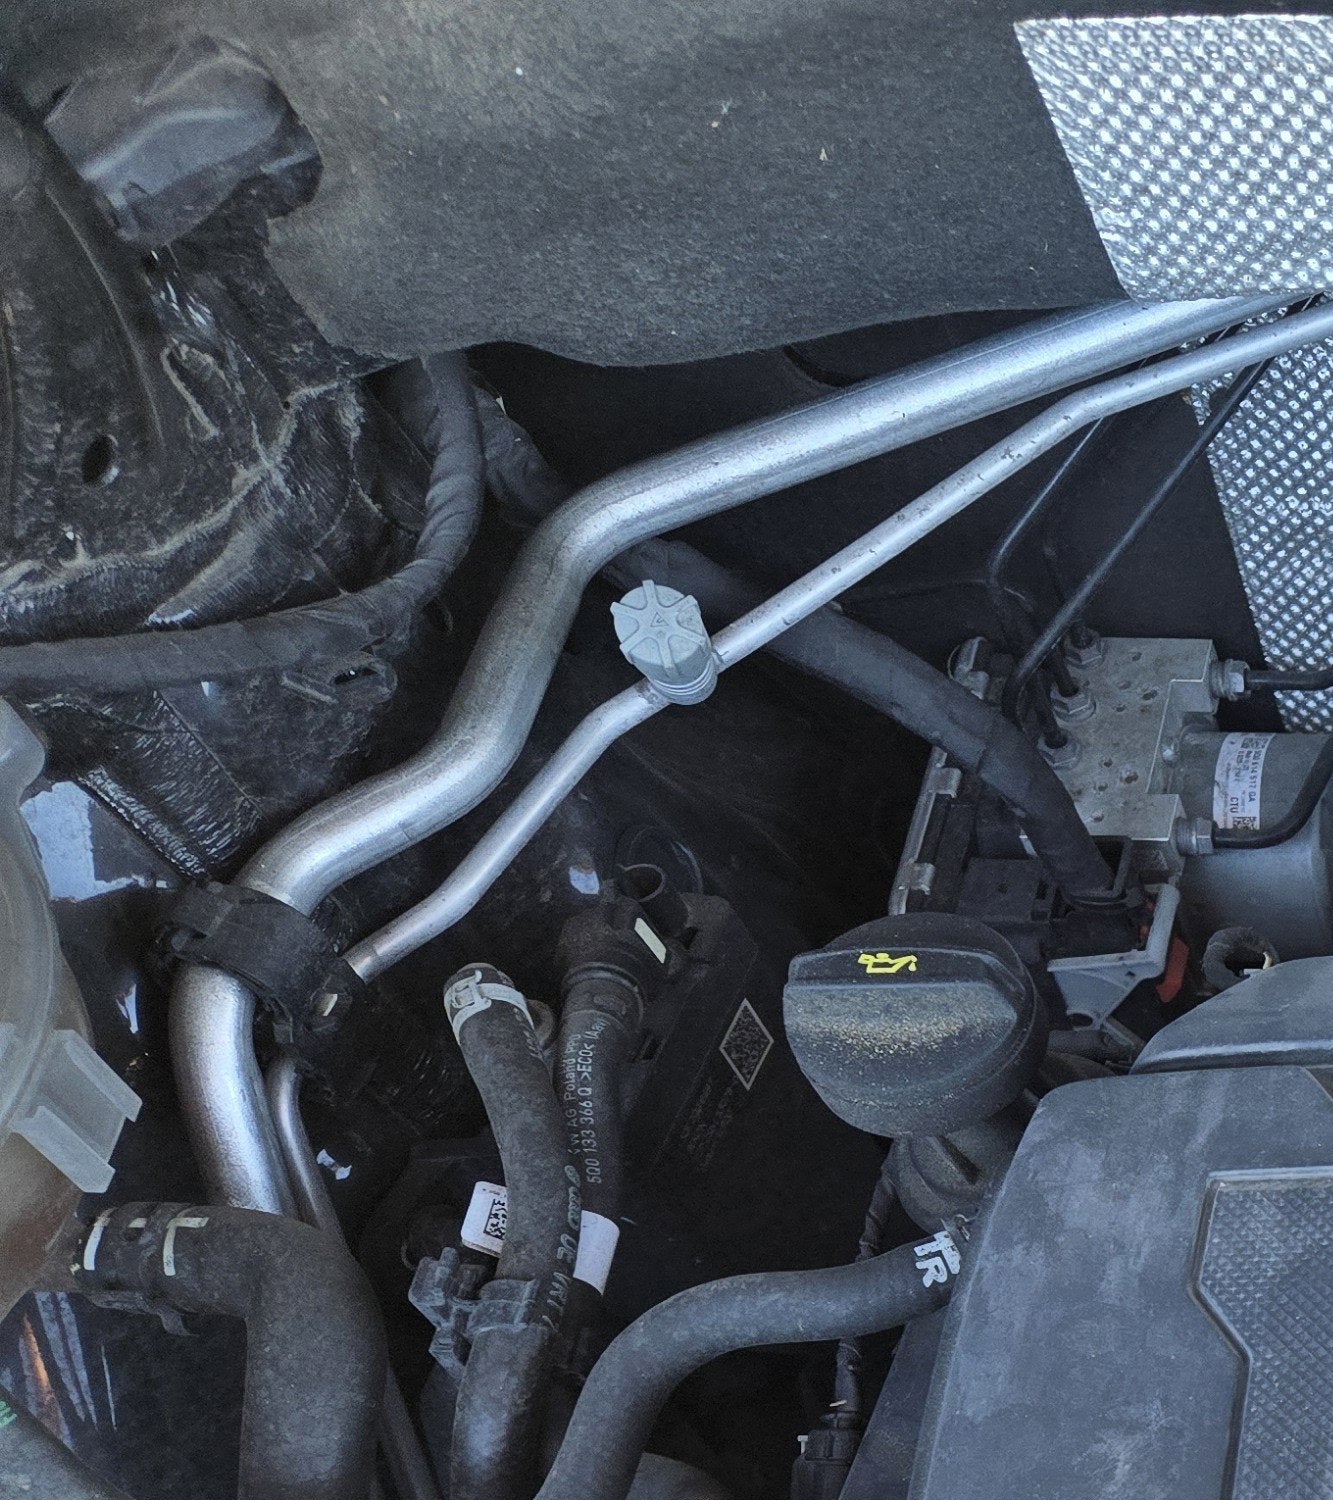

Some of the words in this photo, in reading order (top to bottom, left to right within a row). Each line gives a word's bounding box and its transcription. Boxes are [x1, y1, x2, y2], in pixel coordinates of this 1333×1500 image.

[563, 1057, 575, 1101] Poland
[577, 1086, 592, 1096] Q
[578, 1099, 593, 1125] 366
[581, 1128, 596, 1153] 133
[585, 1157, 601, 1183] 5Q0
